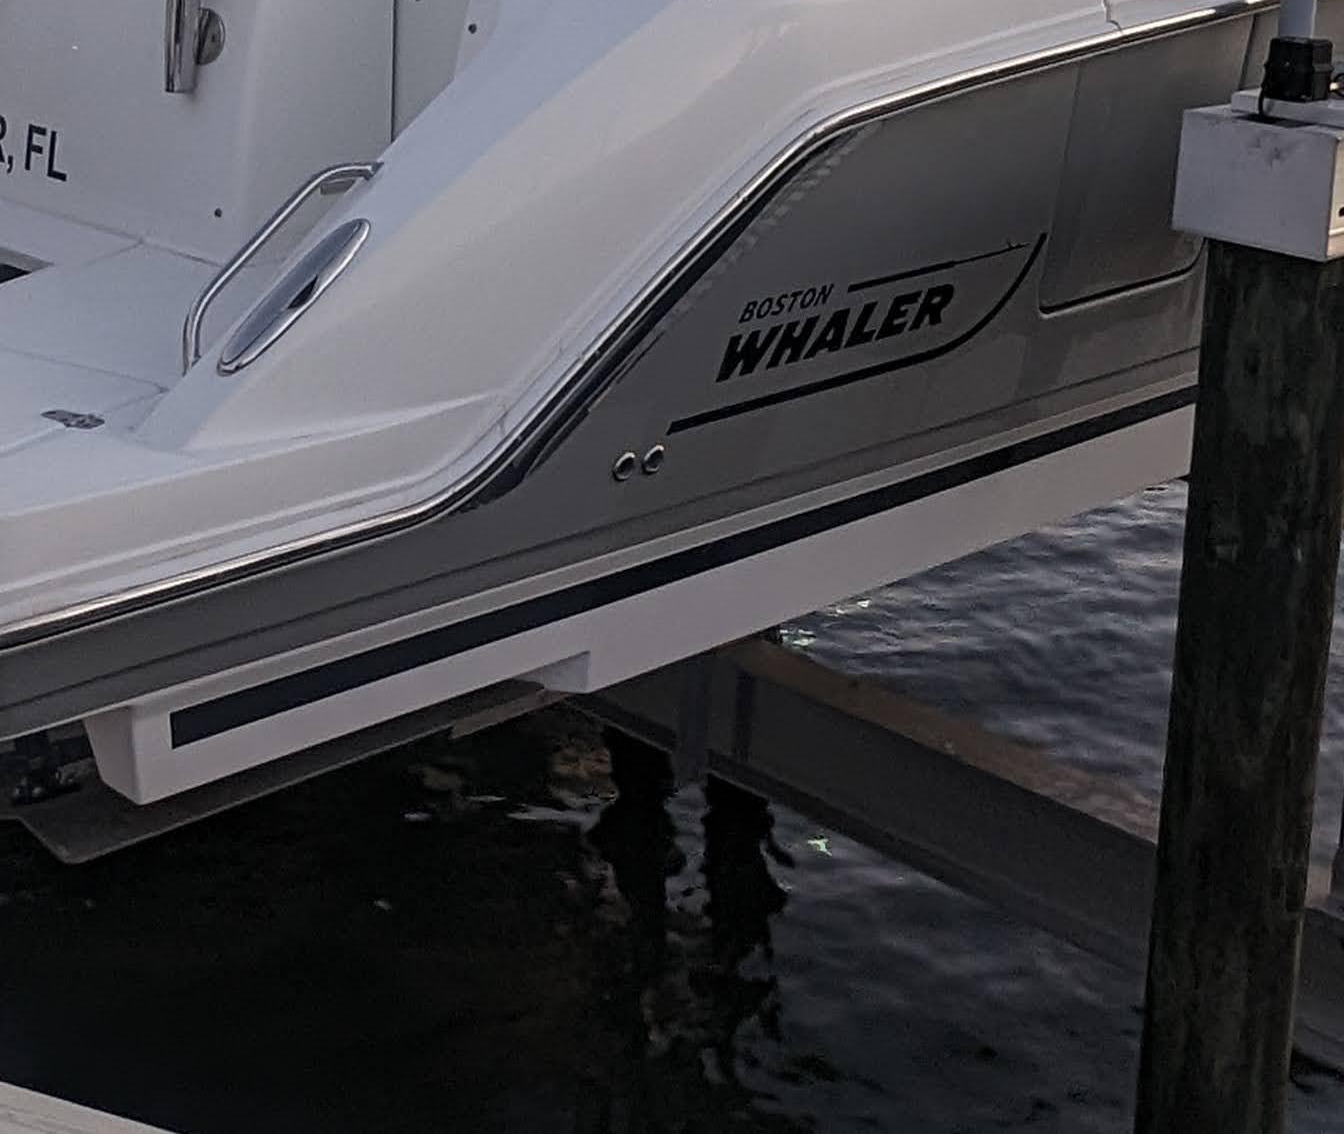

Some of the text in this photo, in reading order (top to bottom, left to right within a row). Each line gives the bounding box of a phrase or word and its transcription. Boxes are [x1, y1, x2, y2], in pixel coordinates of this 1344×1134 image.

[24, 123, 68, 182] FL
[715, 282, 955, 383] WHALER
[738, 283, 835, 324] BOSTON
